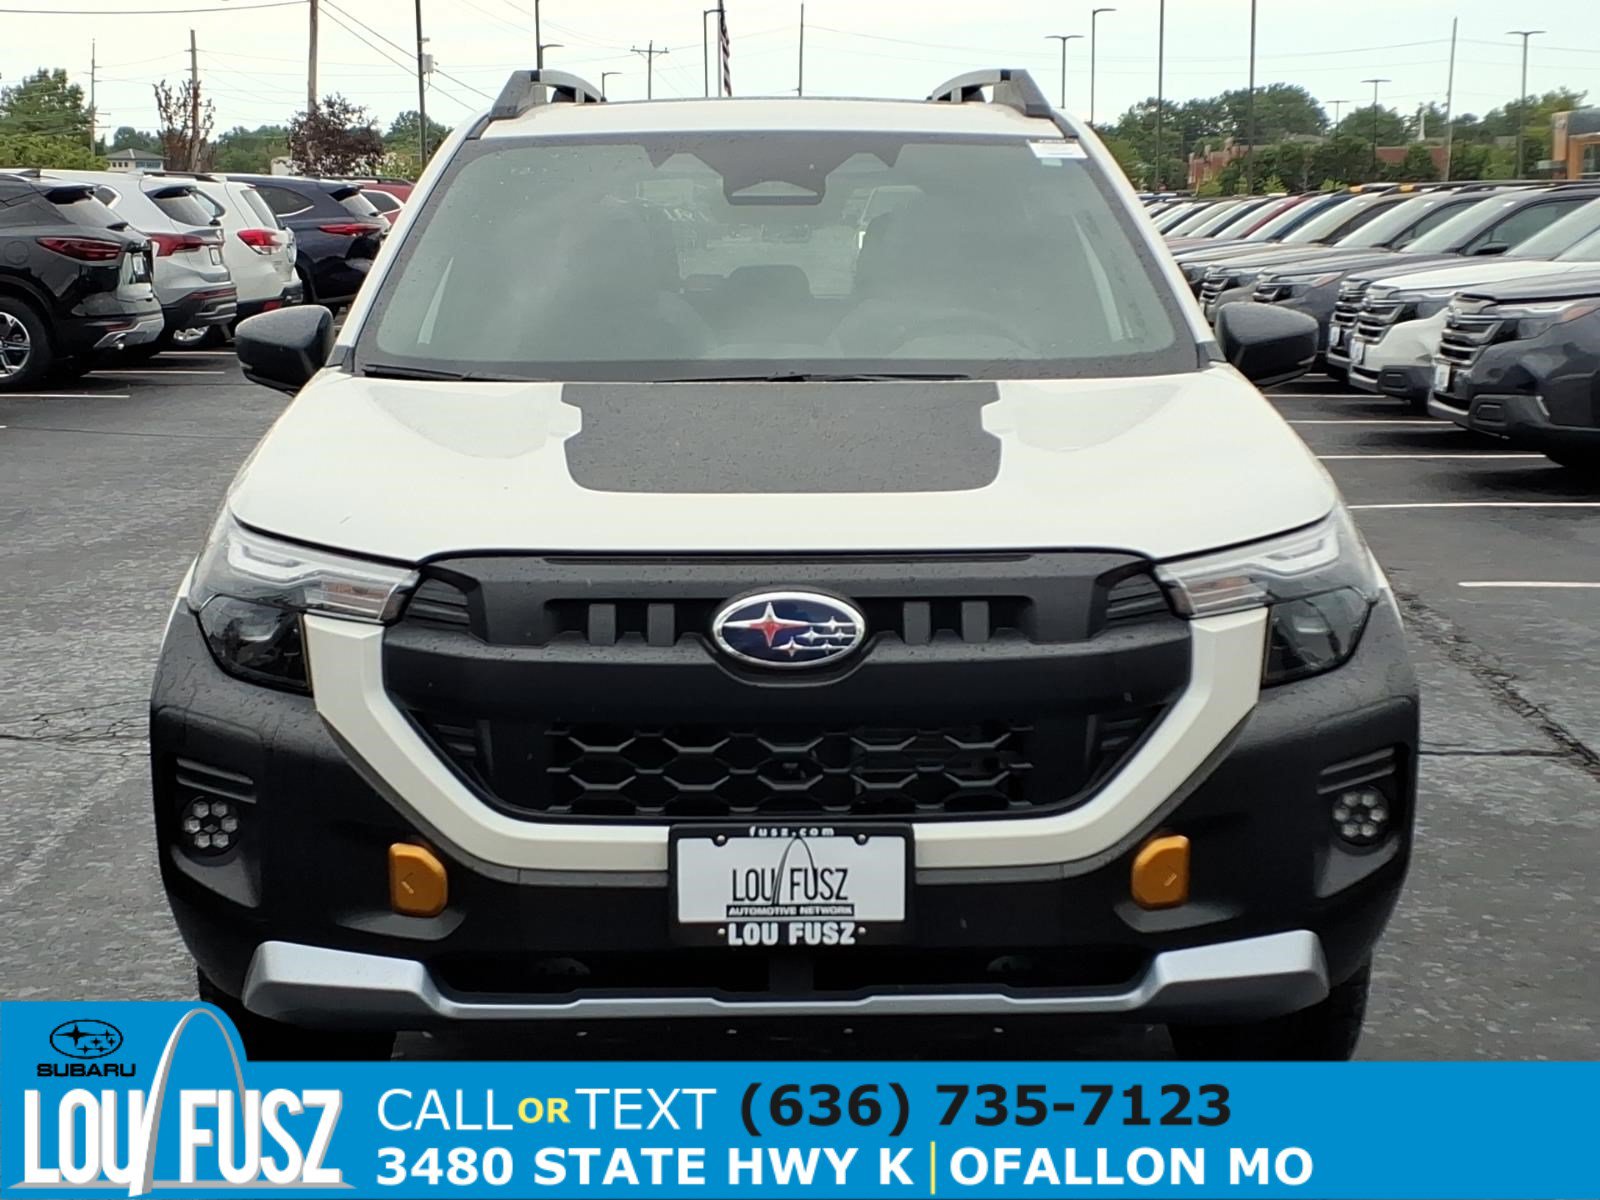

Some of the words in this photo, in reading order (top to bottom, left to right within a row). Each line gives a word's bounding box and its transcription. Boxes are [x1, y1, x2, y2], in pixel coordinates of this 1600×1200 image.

[732, 868, 776, 902] LOU
[790, 867, 848, 901] FUSZ
[729, 906, 797, 916] AUTOMOTIVE
[799, 906, 853, 916] NETWORK
[728, 922, 779, 946] LOU
[788, 921, 856, 946] FUSZ
